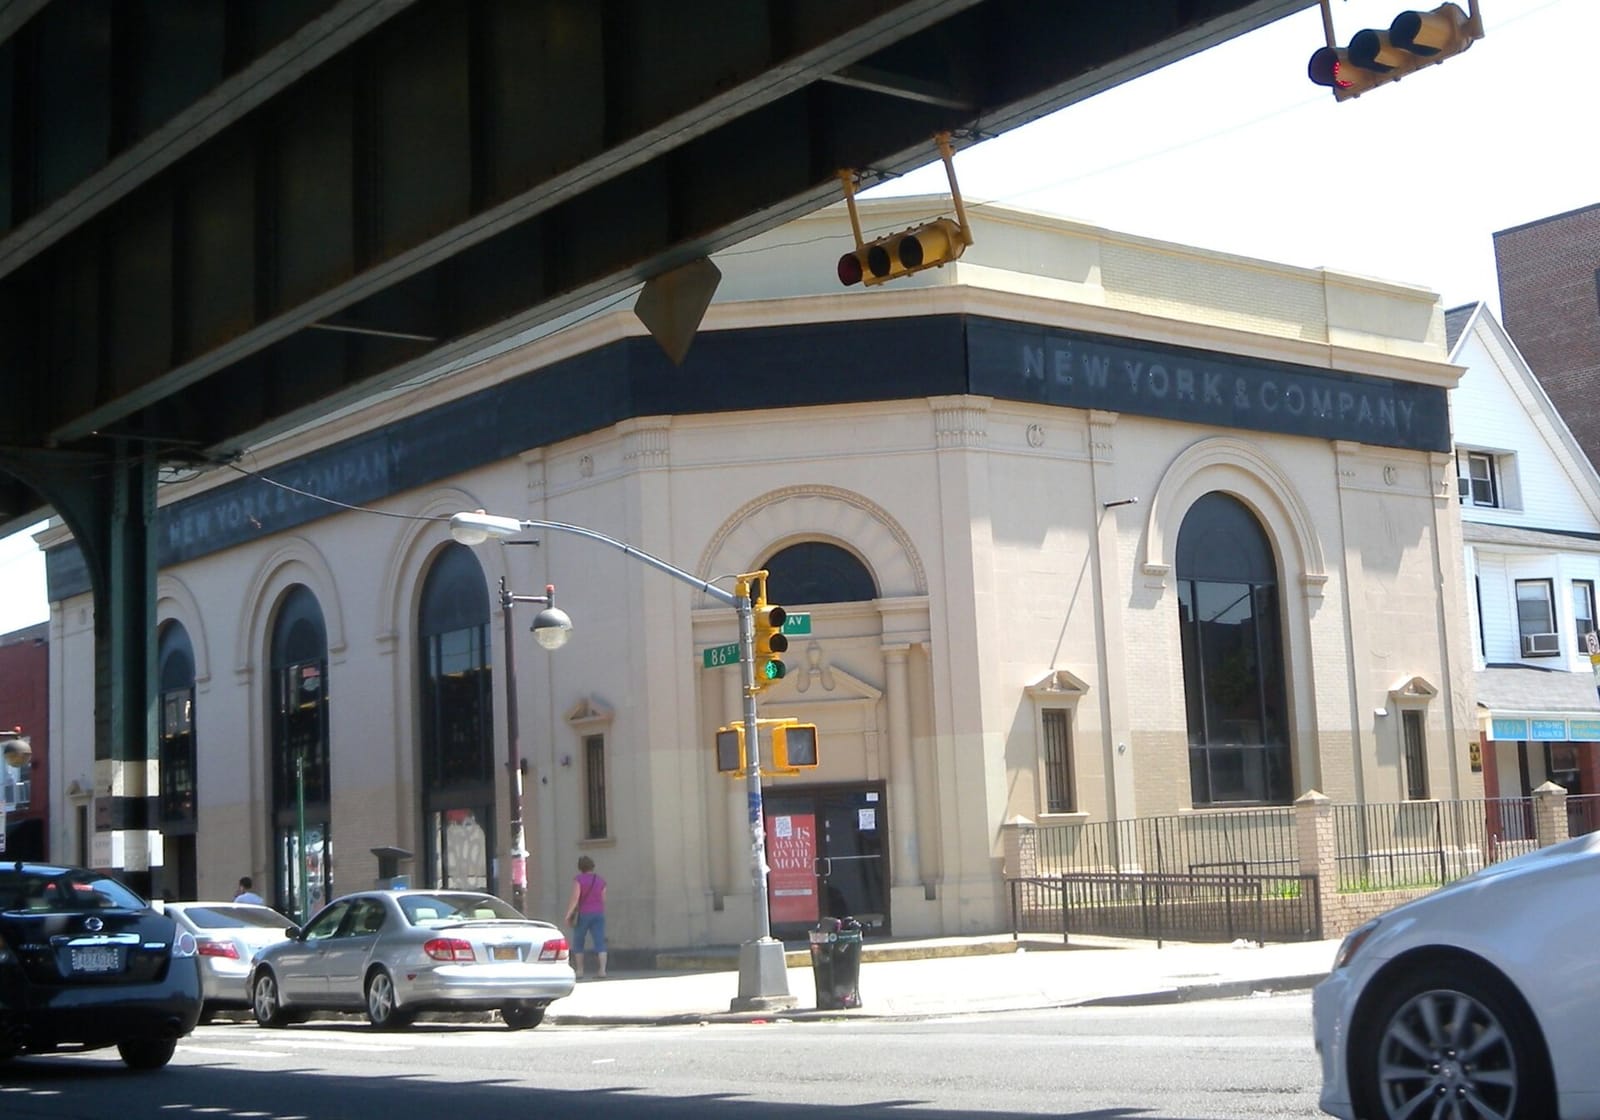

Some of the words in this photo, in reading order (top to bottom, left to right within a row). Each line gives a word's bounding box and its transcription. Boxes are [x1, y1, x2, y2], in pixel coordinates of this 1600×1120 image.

[1022, 344, 1110, 388] NEW
[1124, 359, 1223, 404] YORK
[1233, 378, 1250, 409] &
[1260, 380, 1415, 431] COMPANY
[168, 509, 211, 547] NEW
[215, 491, 269, 528] YORK
[291, 439, 407, 506] COMPANY
[788, 616, 802, 625] AV
[711, 649, 726, 665] 86
[727, 646, 736, 655] ST
